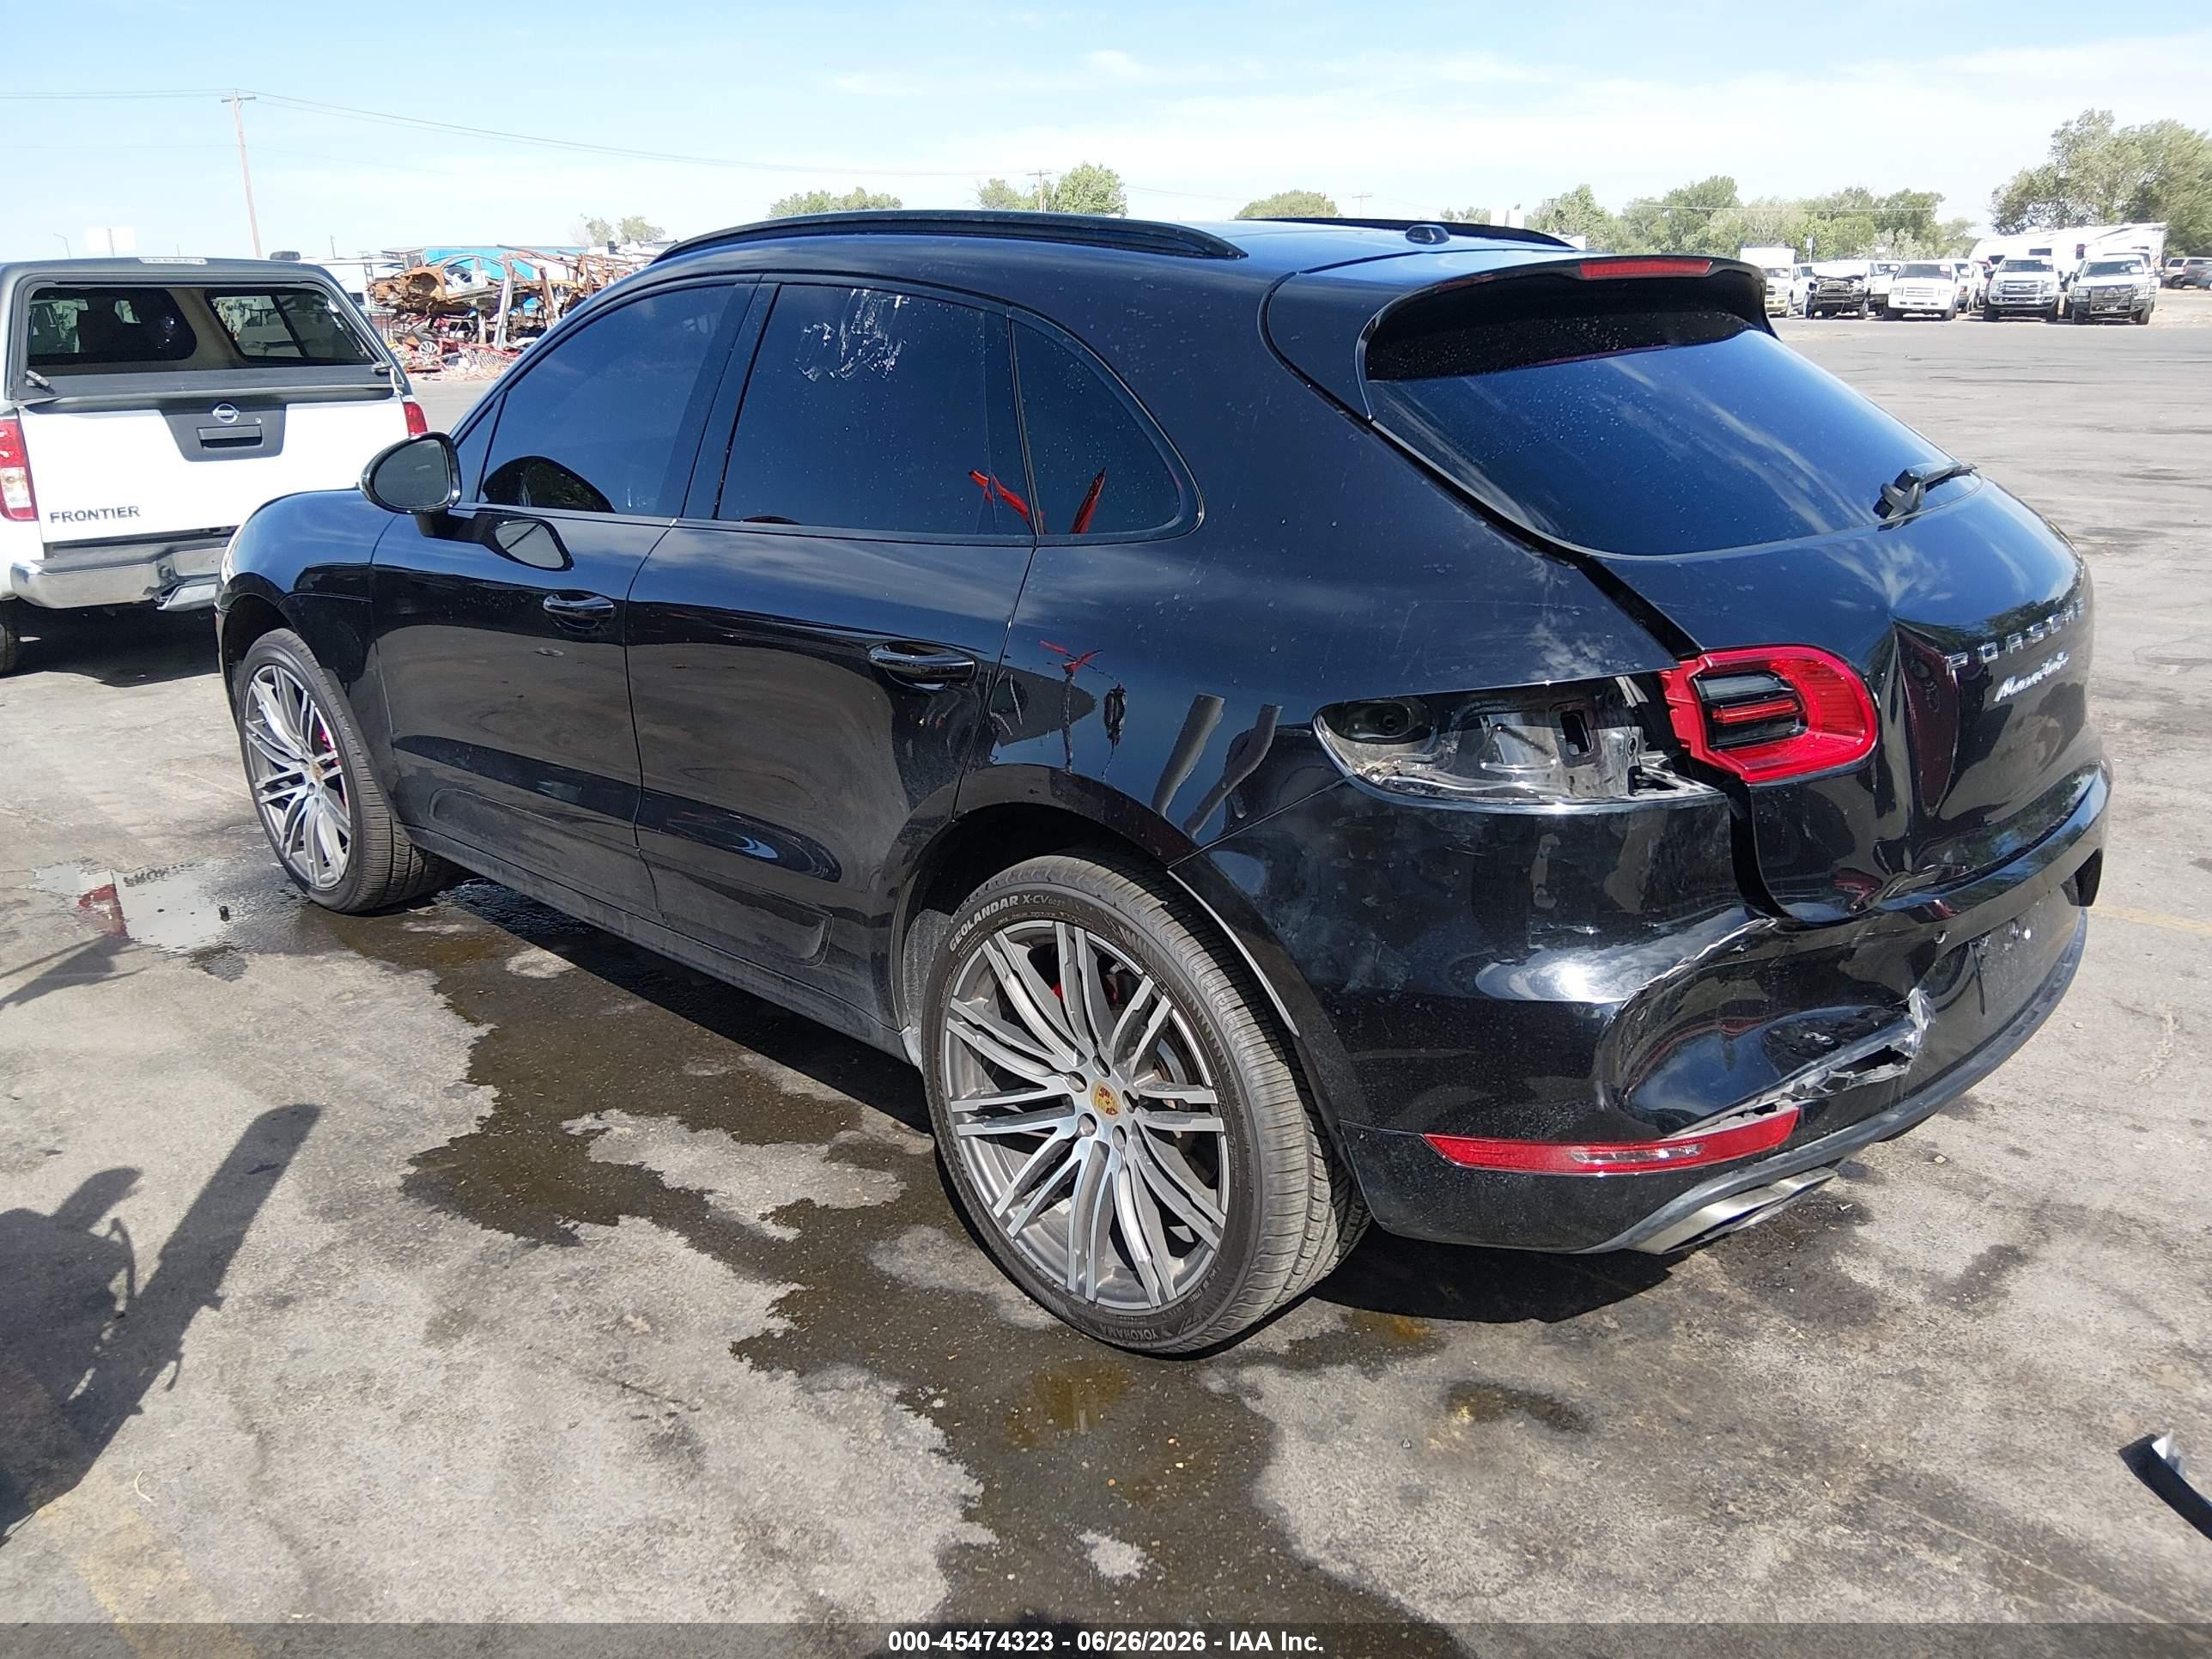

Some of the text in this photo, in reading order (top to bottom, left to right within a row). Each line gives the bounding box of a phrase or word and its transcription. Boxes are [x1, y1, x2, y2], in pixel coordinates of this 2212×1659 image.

[49, 505, 142, 524] FRONTIER
[949, 895, 1019, 952] GEOLANDAR
[1022, 893, 1049, 905] X-CV
[1098, 1322, 1160, 1341] YOKOHAMA
